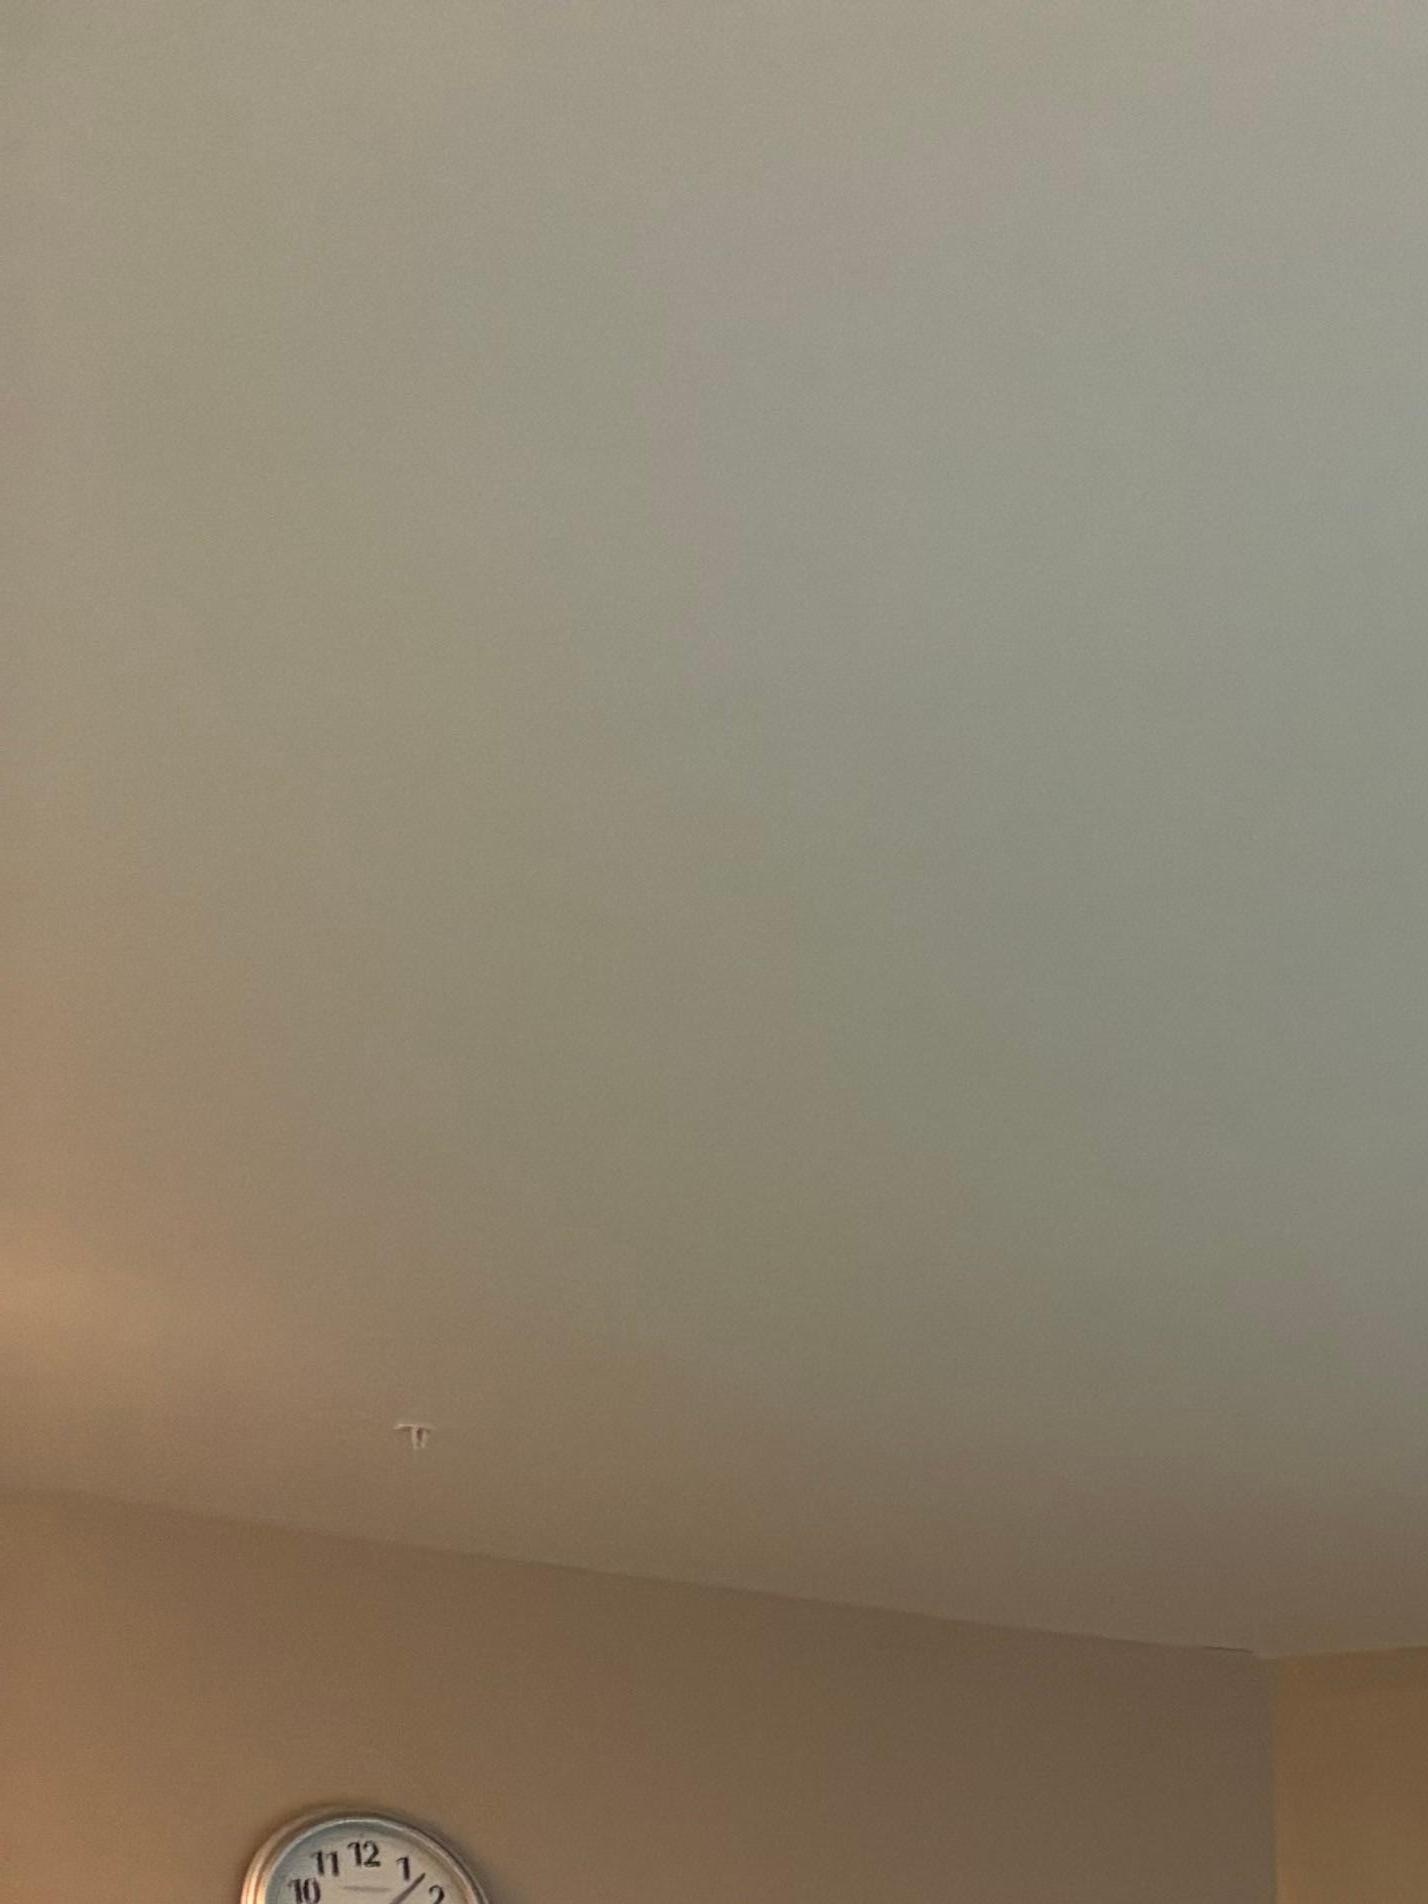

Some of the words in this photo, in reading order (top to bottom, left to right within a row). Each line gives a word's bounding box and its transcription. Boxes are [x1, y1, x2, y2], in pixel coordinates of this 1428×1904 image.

[312, 1851, 339, 1876] 11
[347, 1840, 380, 1867] 12
[397, 1857, 410, 1881] 1
[288, 1878, 320, 1904] 10
